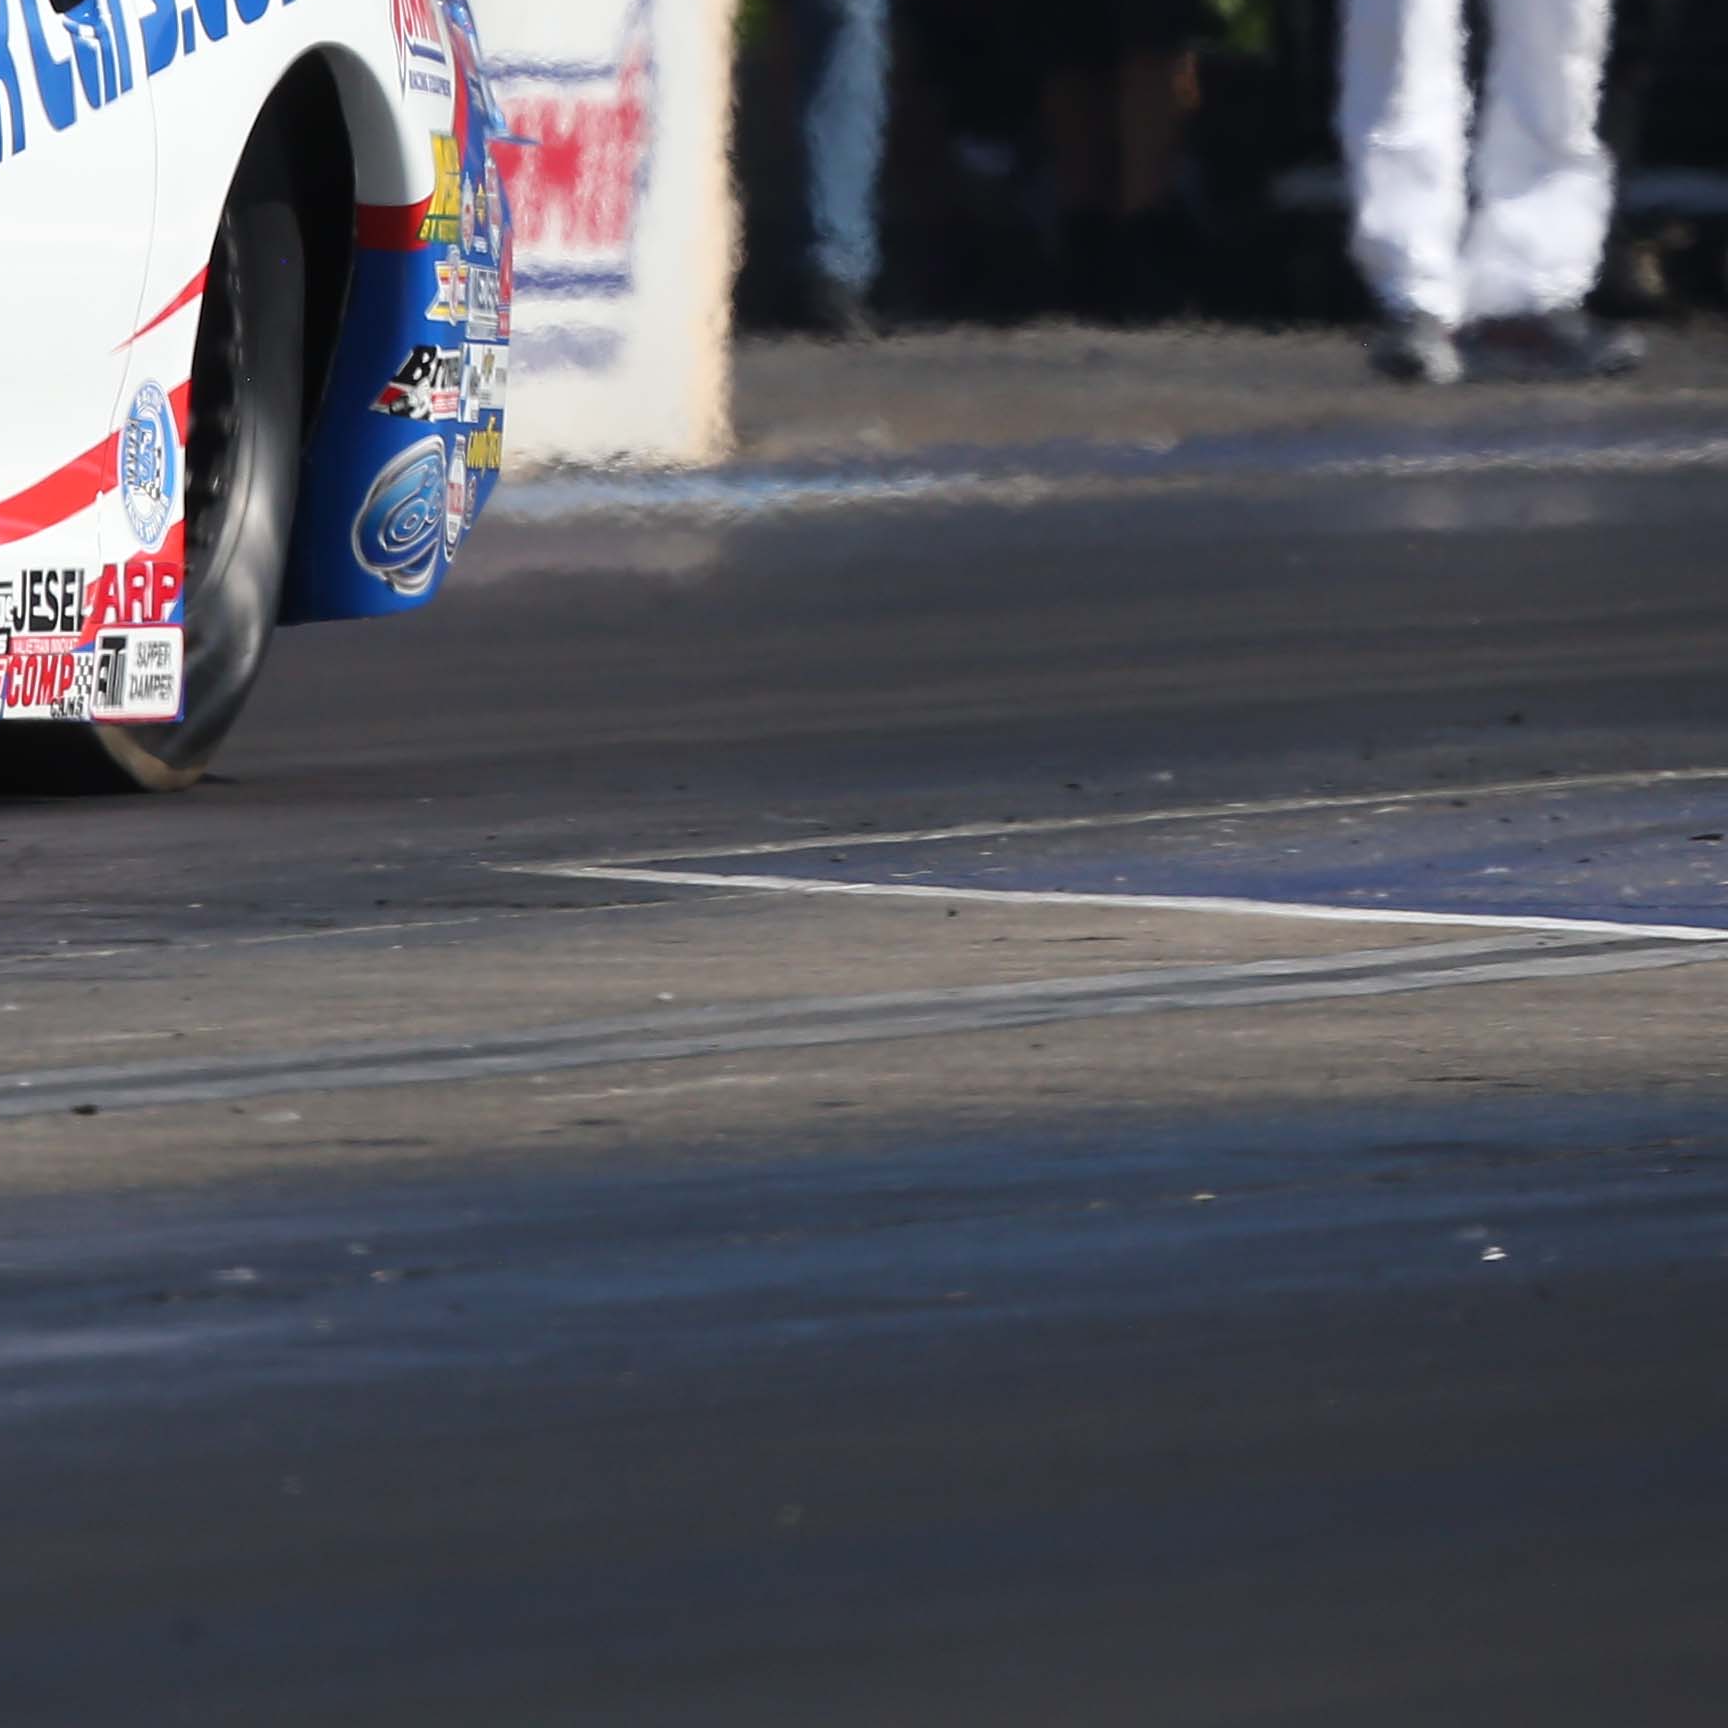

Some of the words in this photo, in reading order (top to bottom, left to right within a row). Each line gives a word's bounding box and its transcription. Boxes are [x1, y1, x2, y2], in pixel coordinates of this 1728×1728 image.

[11, 568, 87, 632] JESEL
[91, 561, 181, 624] ARP
[6, 654, 77, 708] COMP
[136, 640, 171, 669] SUPER
[128, 673, 175, 702] DAMPER
